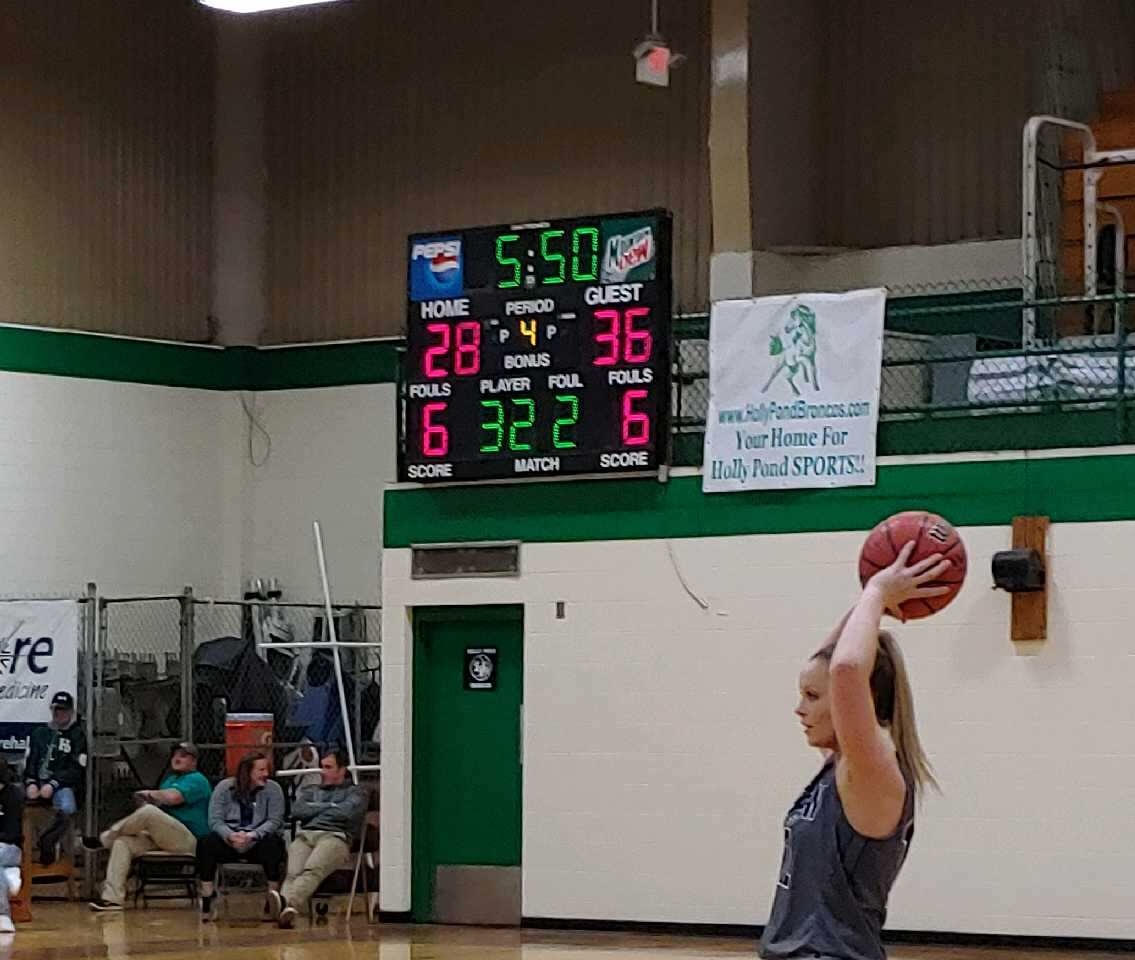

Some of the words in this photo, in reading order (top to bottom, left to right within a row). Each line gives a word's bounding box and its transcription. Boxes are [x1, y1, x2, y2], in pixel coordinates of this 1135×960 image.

[496, 226, 599, 288] 5:50
[584, 283, 643, 305] GUEST
[421, 299, 470, 319] HOME
[505, 299, 554, 316] PERIOD
[519, 319, 537, 346] 4
[593, 307, 652, 366] 36
[425, 320, 481, 378] 28
[504, 352, 551, 369] BONUS
[480, 377, 531, 393] PLAYER
[548, 374, 583, 390] FOUL
[608, 368, 653, 385] FOULS
[410, 383, 451, 398] FOULS
[480, 398, 535, 453] 32
[553, 395, 579, 449] 2
[622, 390, 650, 446] 6
[423, 402, 448, 457] 6
[736, 429, 768, 450] Your
[771, 427, 817, 448] Home
[823, 426, 848, 446] For
[514, 457, 560, 473] MATCH
[600, 451, 648, 468] SCORE
[712, 458, 750, 483] Holly
[752, 455, 789, 478] Pond
[408, 464, 453, 478] SCORE
